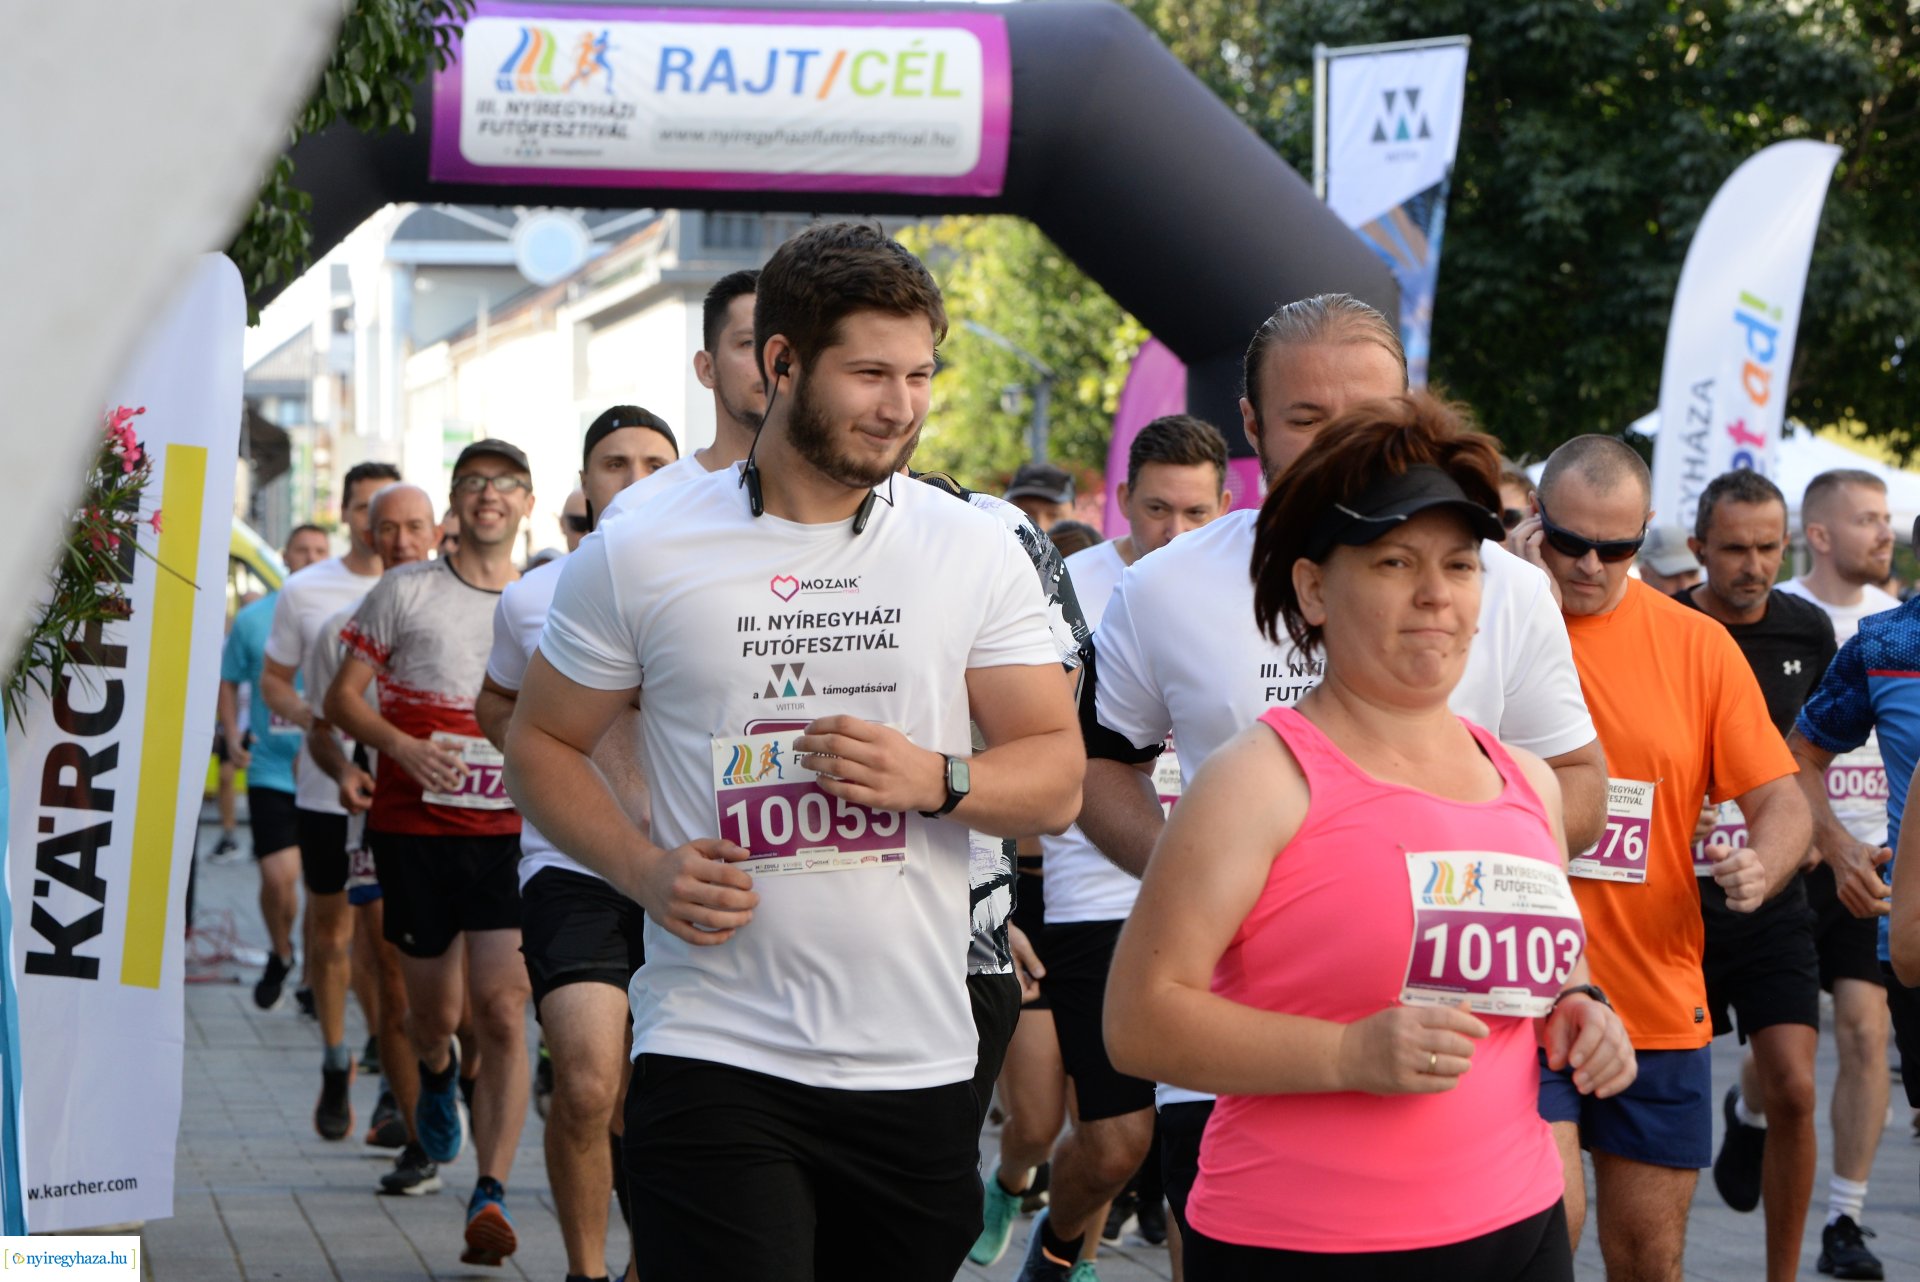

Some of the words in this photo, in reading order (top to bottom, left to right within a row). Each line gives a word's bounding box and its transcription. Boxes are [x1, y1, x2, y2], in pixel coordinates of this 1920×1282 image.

[655, 37, 963, 100] RAJT/CÉL
[478, 116, 629, 139] FUTÓFESZTIVÁL
[801, 578, 858, 590] MOZAIK
[737, 616, 761, 632] III.
[768, 605, 901, 631] NYÍREGYHÁZI
[742, 629, 899, 657] FUTÓFESZTIVÁL
[1260, 664, 1283, 678] III.
[822, 683, 897, 697] támogatásával
[24, 440, 145, 981] KÄRCH
[776, 703, 805, 711] WITTUR
[1607, 795, 1644, 806] ESZTIVÁL
[726, 792, 900, 848] 10055
[1582, 823, 1644, 861] 76
[1423, 922, 1581, 985] 10103
